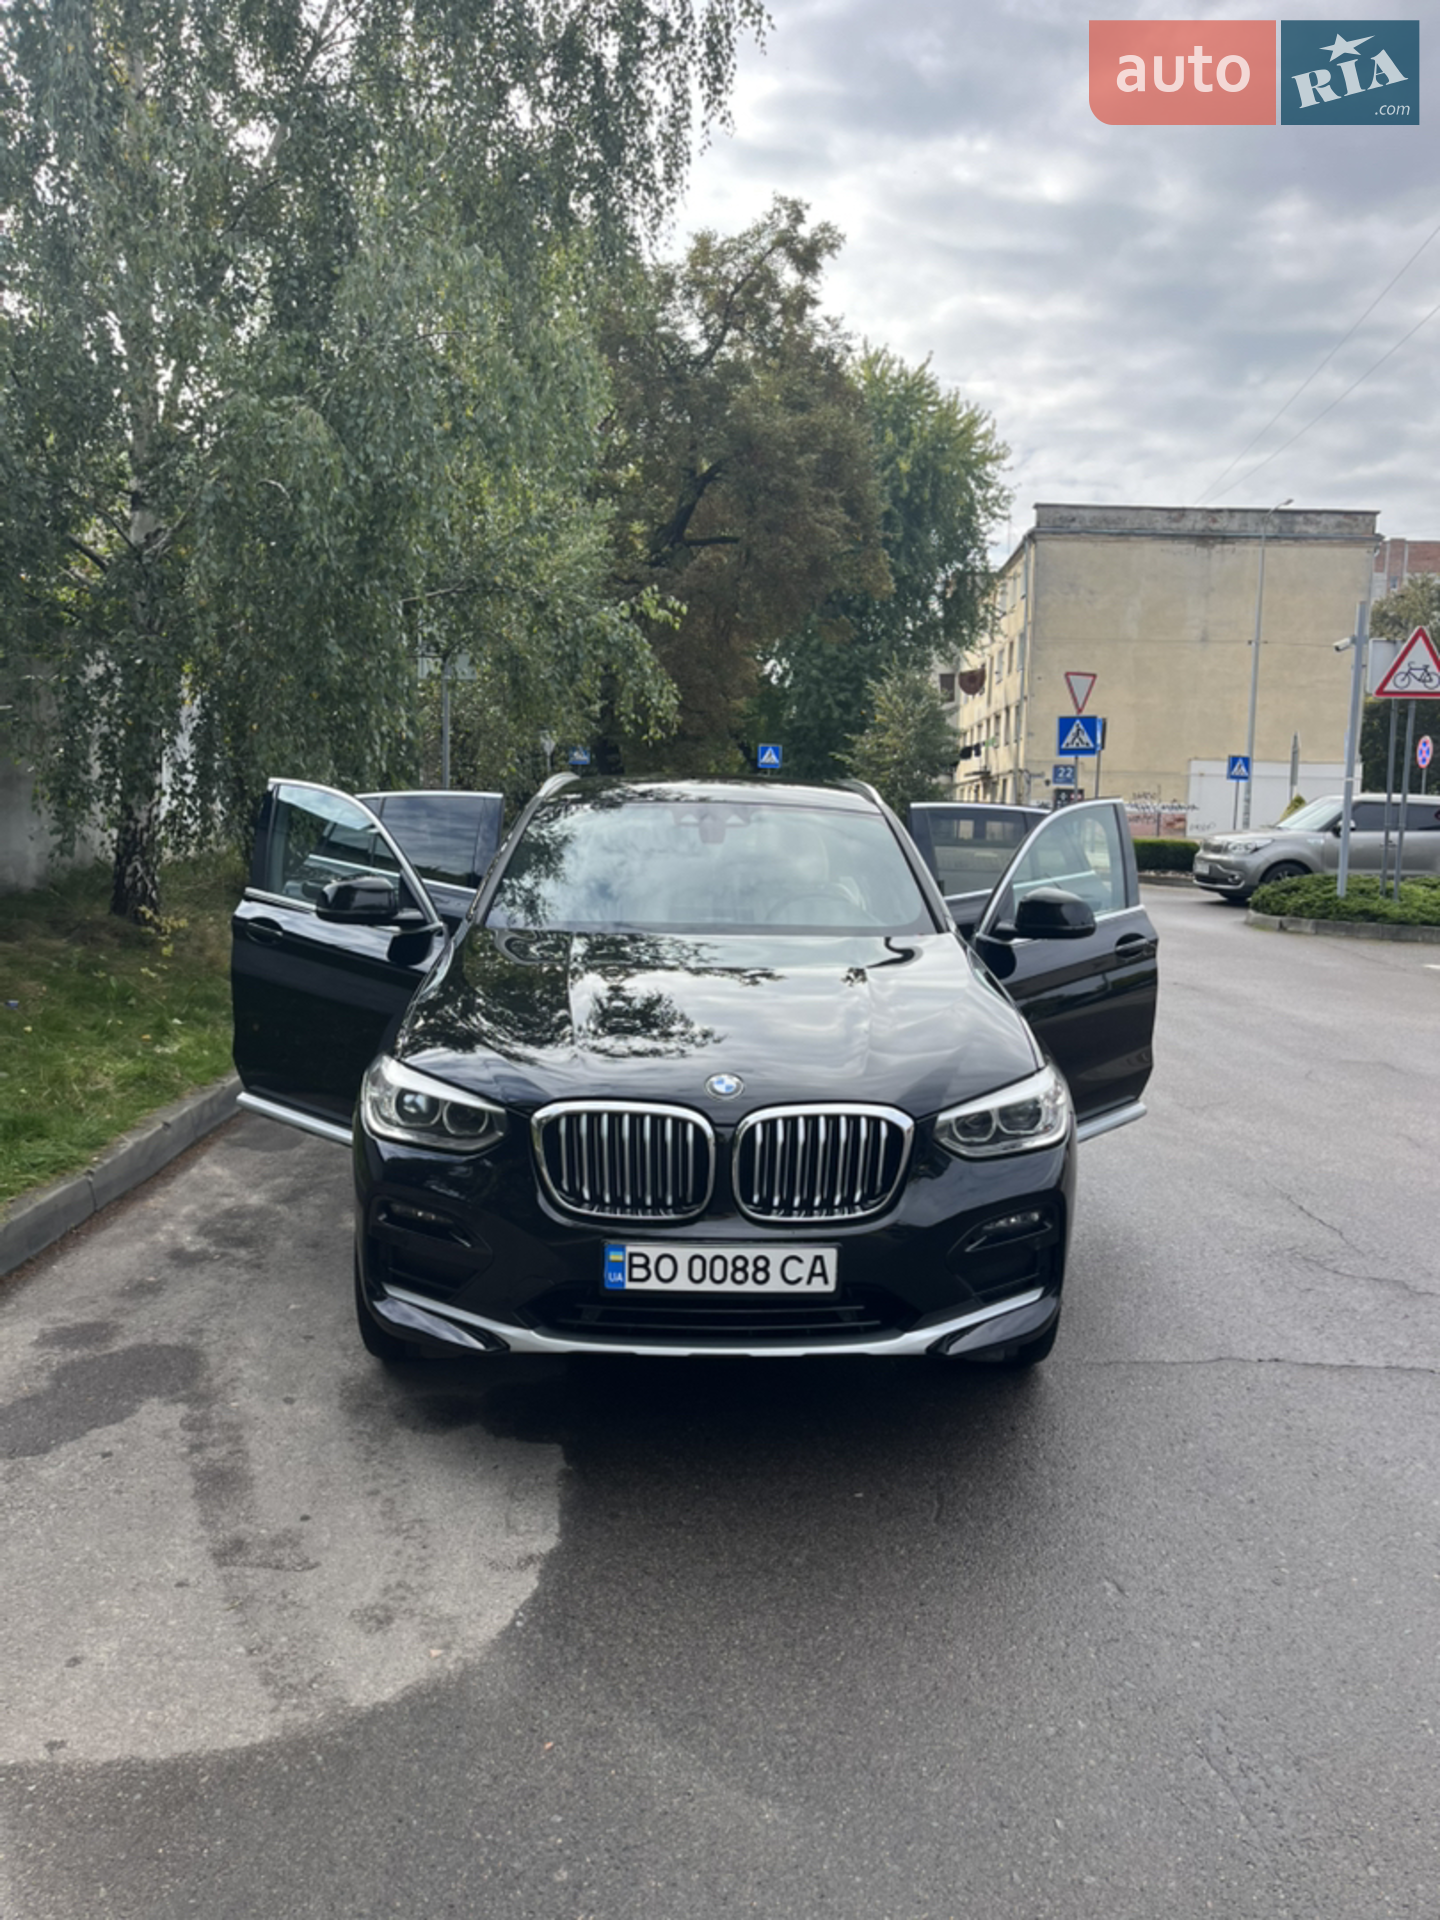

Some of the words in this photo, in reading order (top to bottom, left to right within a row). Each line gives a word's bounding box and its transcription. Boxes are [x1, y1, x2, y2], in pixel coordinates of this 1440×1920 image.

[1058, 767, 1073, 779] 22
[627, 1252, 678, 1284] BO
[687, 1254, 770, 1286] 0088
[780, 1254, 829, 1286] CA
[607, 1272, 624, 1283] UA
